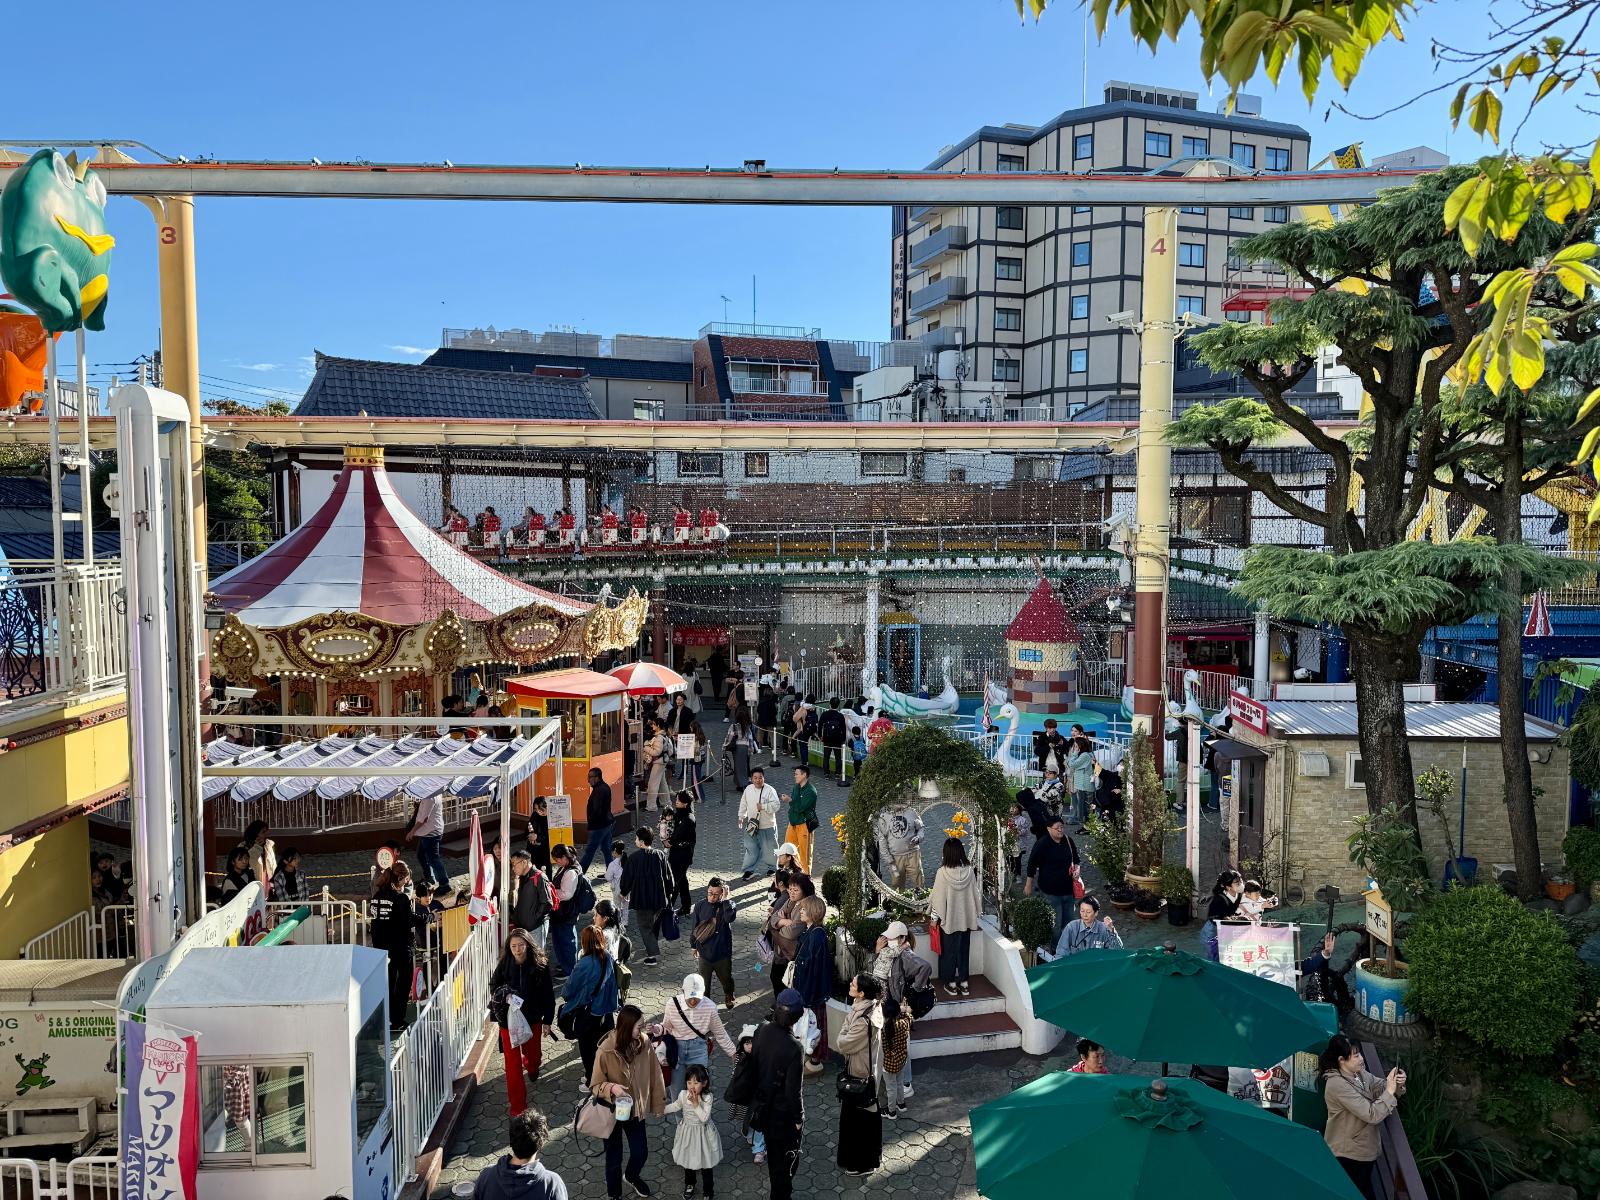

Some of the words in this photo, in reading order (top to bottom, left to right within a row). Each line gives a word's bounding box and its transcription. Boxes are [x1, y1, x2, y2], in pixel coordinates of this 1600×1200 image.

[161, 226, 176, 244] 3
[1151, 237, 1166, 255] 4
[48, 1018, 54, 1027] S
[56, 1017, 63, 1027] &
[65, 1017, 71, 1027] S
[73, 1016, 116, 1027] ORIGINAL
[48, 1027, 116, 1038] AMUSEMENTS
[144, 1087, 177, 1200] マリオン
